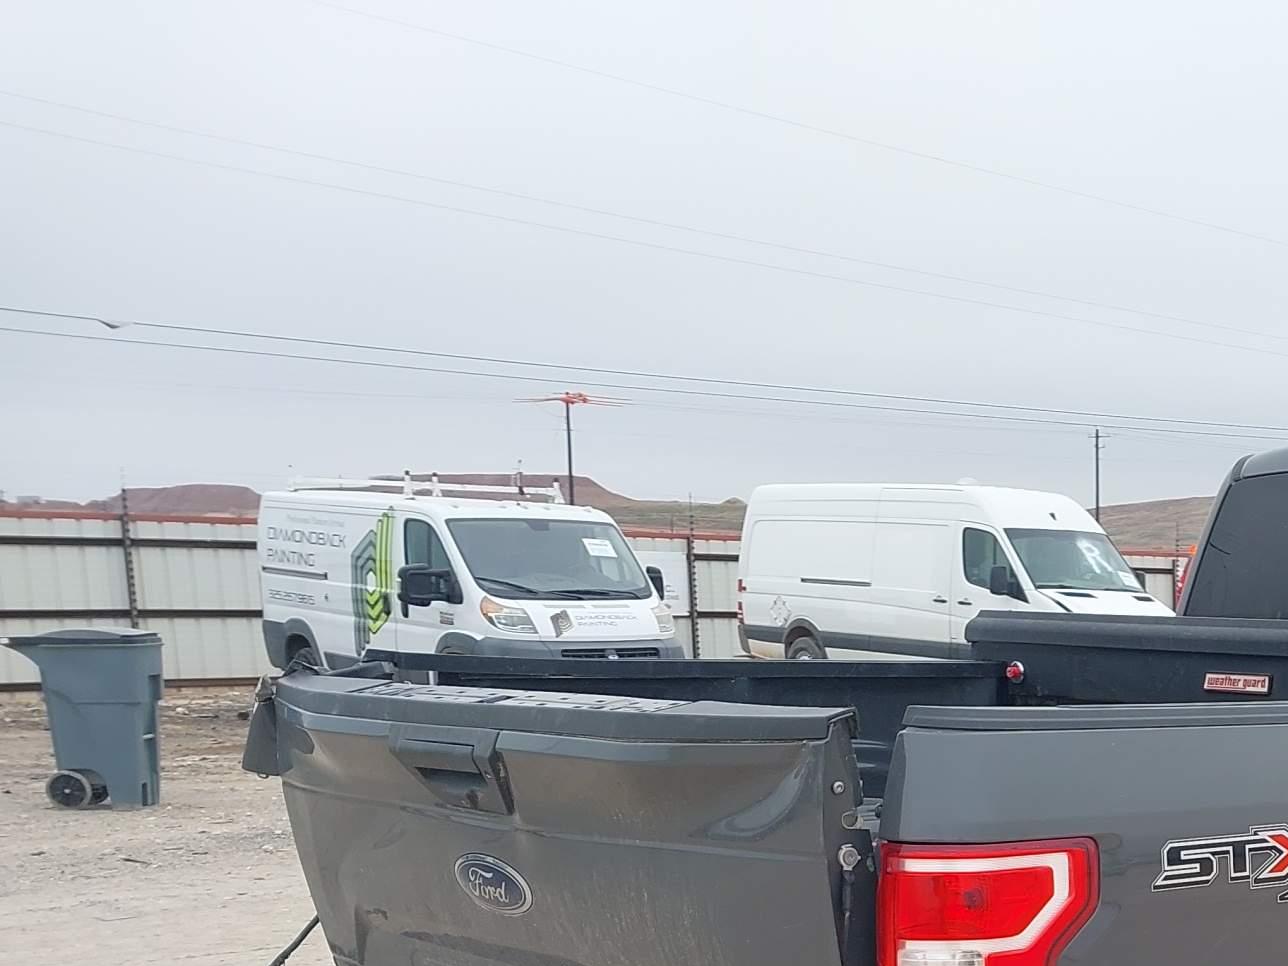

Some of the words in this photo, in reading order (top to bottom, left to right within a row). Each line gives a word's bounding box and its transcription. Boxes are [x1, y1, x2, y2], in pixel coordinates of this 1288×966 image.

[1207, 675, 1241, 688] weather
[1242, 678, 1267, 690] guard
[468, 866, 512, 903] Ford
